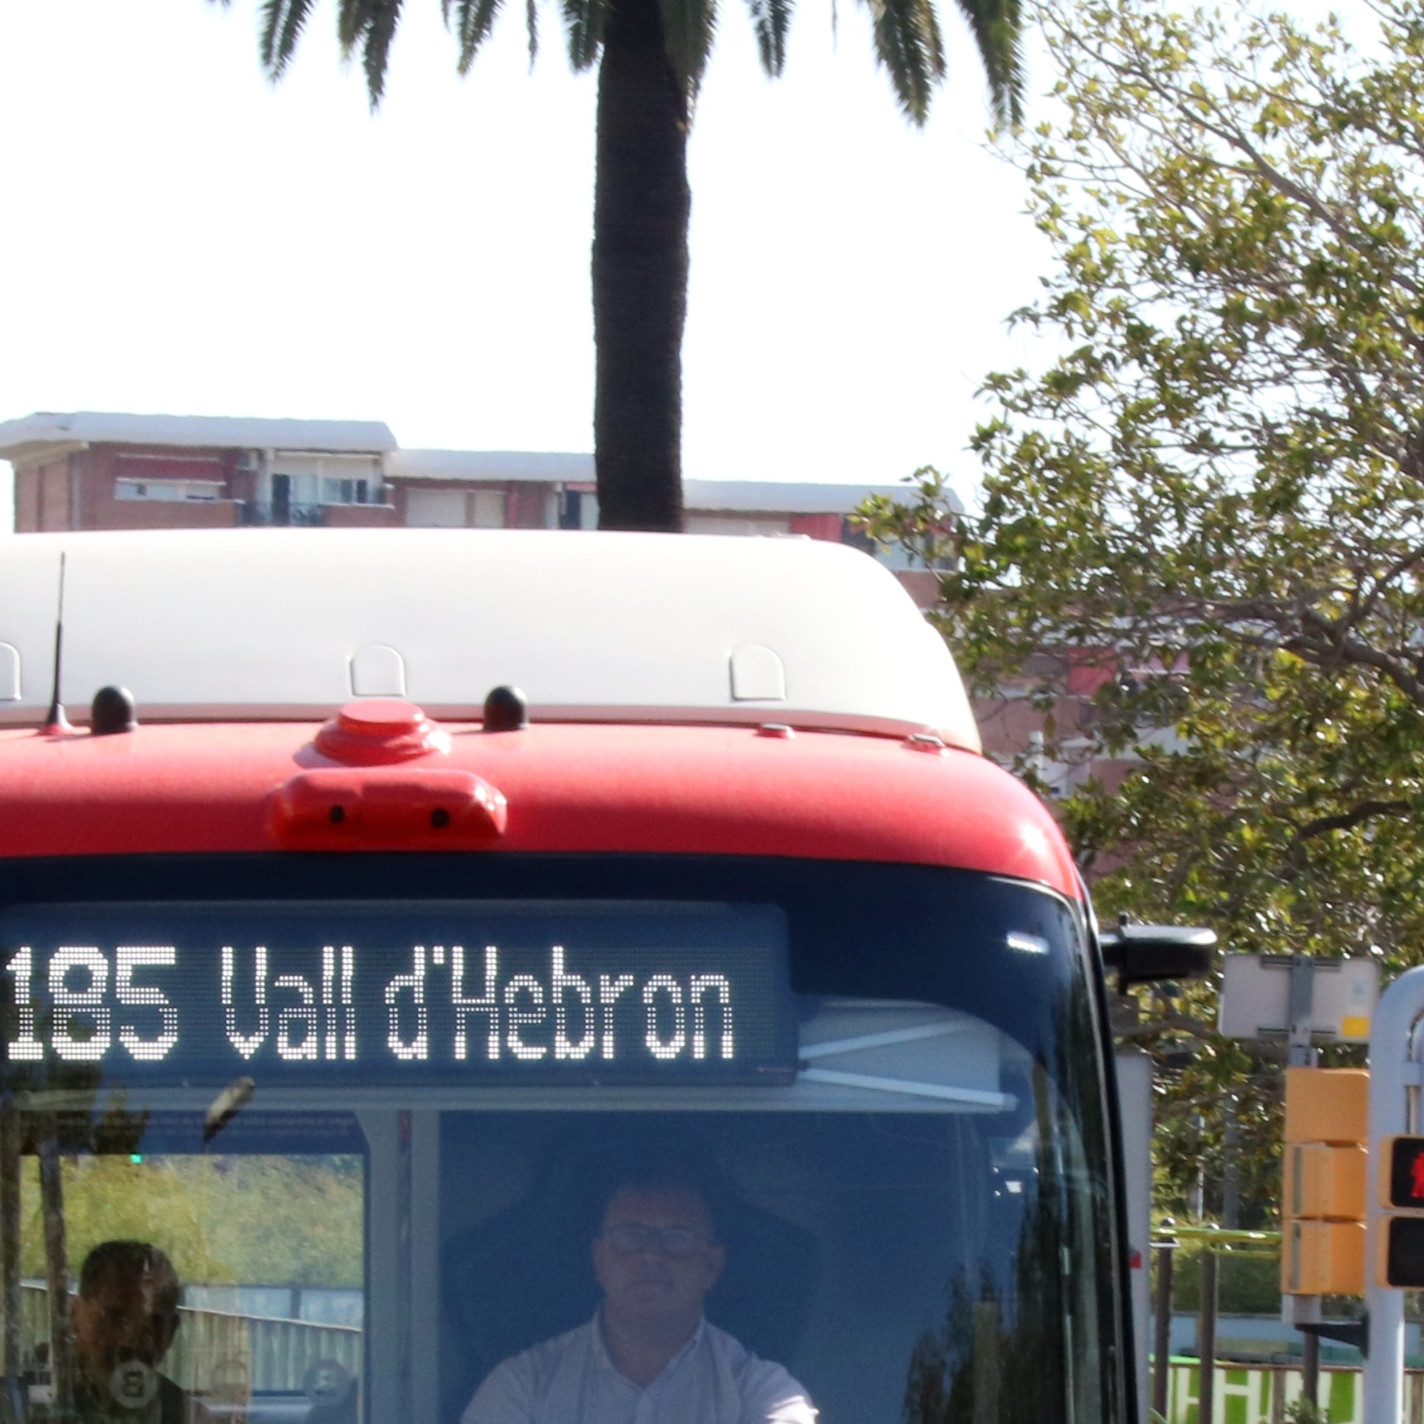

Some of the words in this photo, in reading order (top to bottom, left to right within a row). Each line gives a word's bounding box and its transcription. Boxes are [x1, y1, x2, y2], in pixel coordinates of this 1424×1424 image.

[6, 946, 177, 1060] 185
[222, 946, 355, 1060] Vall
[385, 946, 734, 1060] d'Hebron
